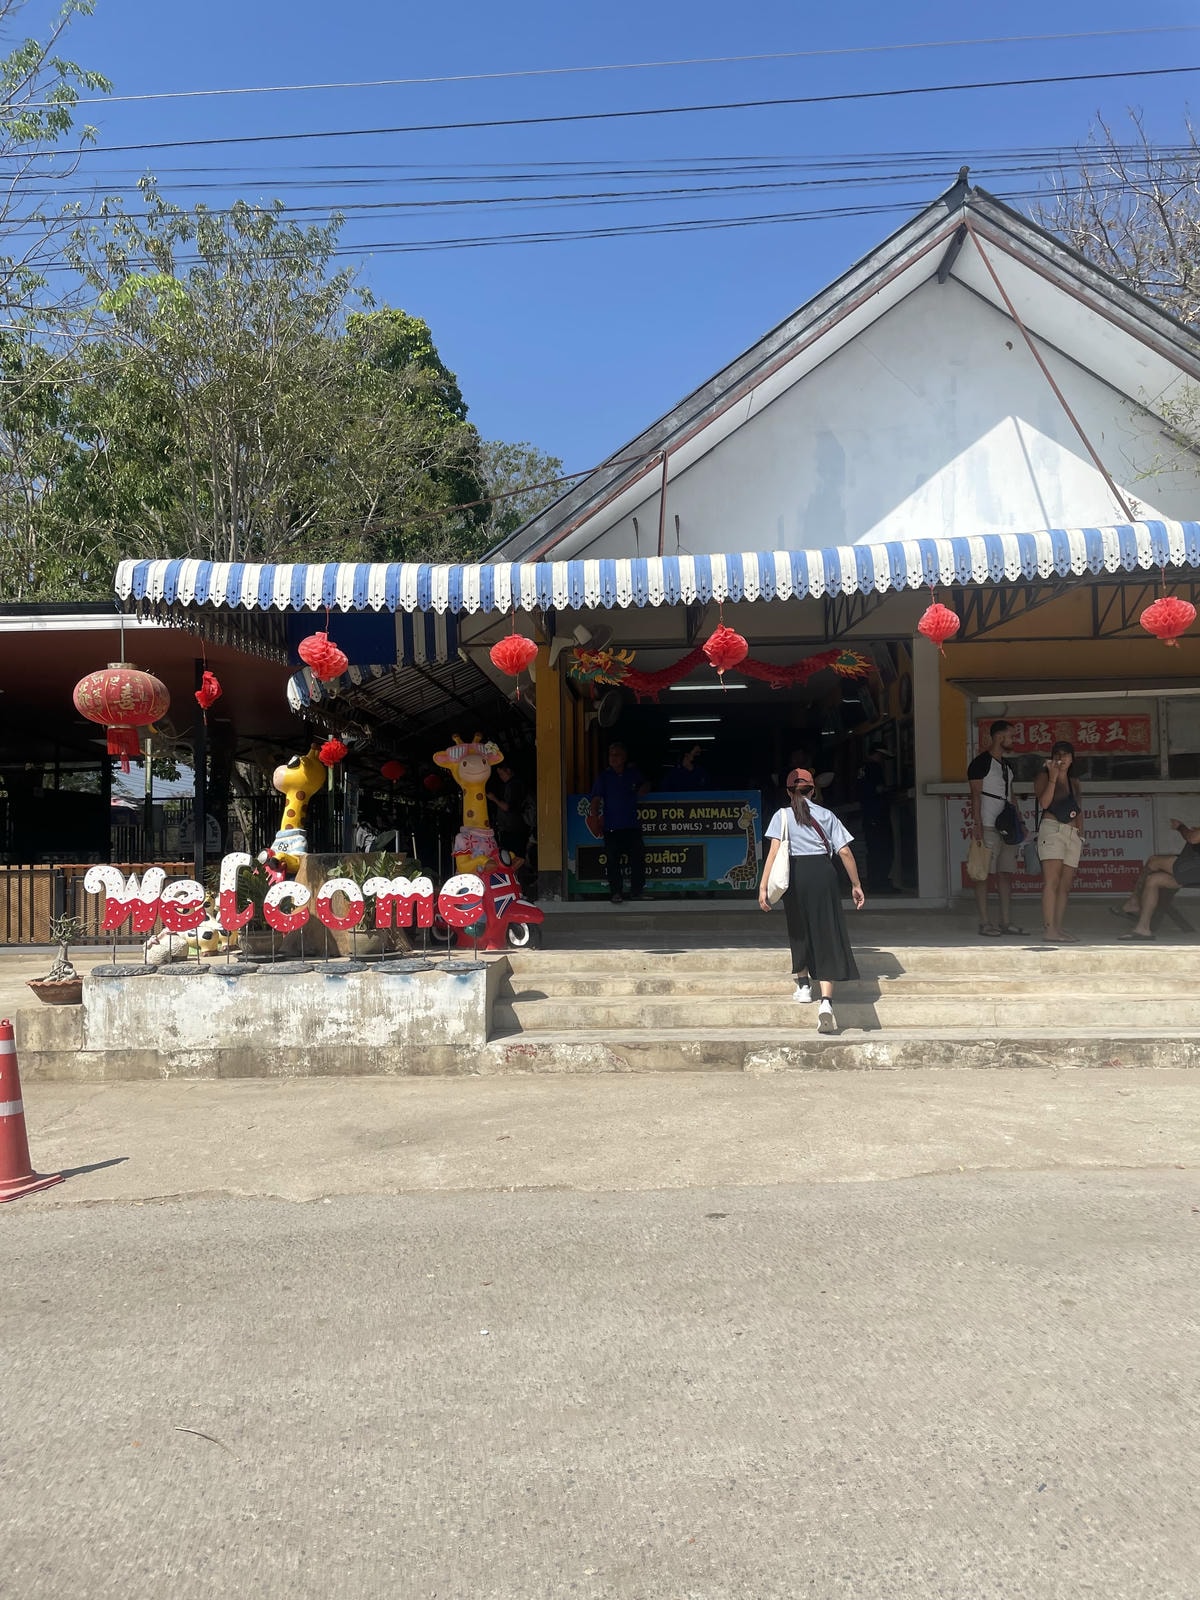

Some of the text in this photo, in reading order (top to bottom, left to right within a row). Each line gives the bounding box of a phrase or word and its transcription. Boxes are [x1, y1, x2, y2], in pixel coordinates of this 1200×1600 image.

[637, 807, 741, 820] OD FOR ANIMALS
[641, 823, 656, 832] SET
[671, 822, 703, 831] BOWLS)
